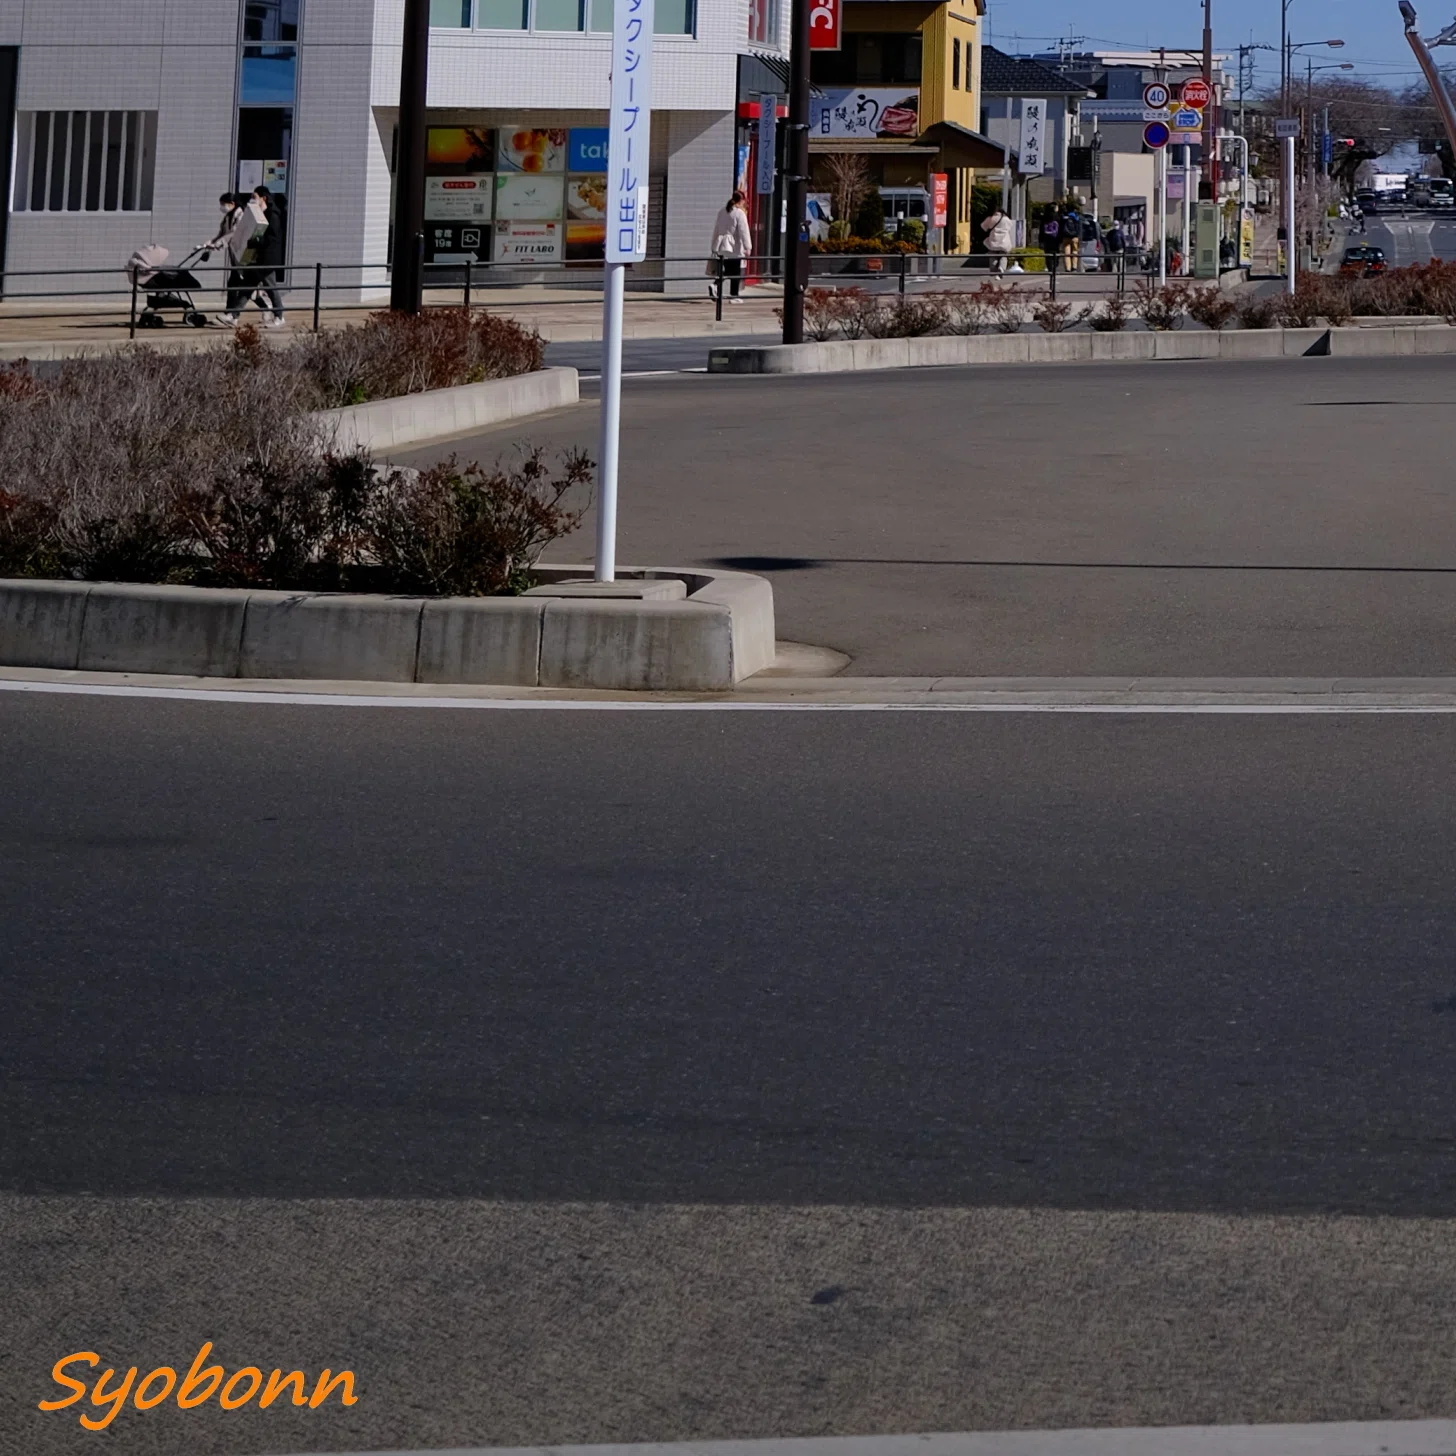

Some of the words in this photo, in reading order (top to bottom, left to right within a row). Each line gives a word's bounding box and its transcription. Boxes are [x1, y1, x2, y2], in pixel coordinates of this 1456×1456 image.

[1150, 90, 1165, 102] 40
[1185, 89, 1208, 101] 消火栓
[761, 97, 773, 191] タクシープール入口
[514, 245, 529, 253] FIT
[530, 245, 555, 253] LABO
